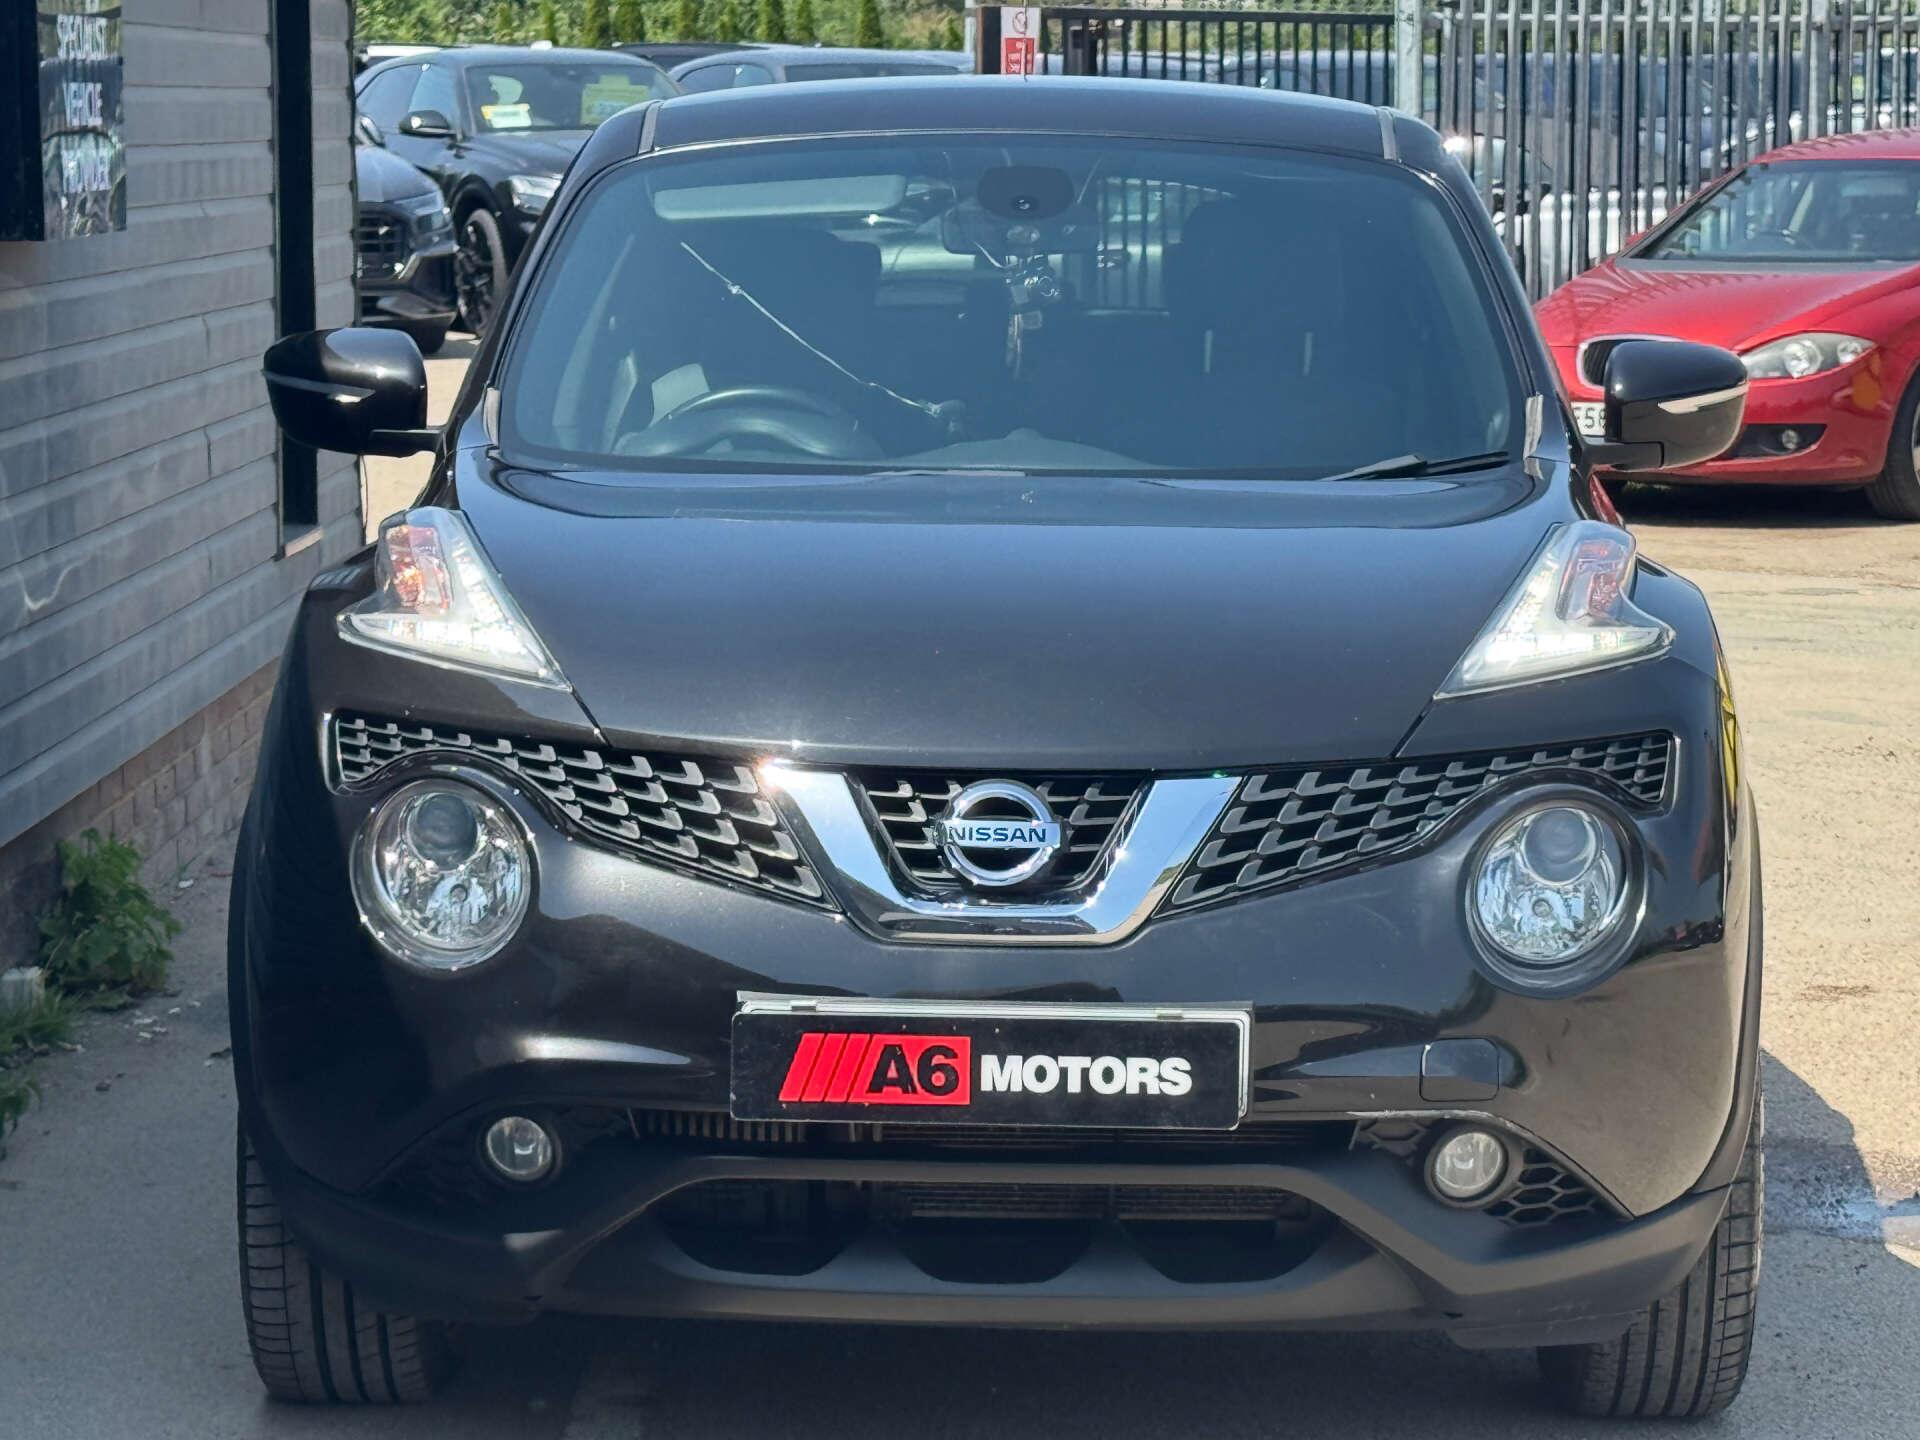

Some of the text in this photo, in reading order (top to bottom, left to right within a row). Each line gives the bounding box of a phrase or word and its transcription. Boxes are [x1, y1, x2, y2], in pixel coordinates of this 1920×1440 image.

[947, 826, 1046, 842] NISSAN
[867, 1045, 1192, 1096] A6 MOTORS
